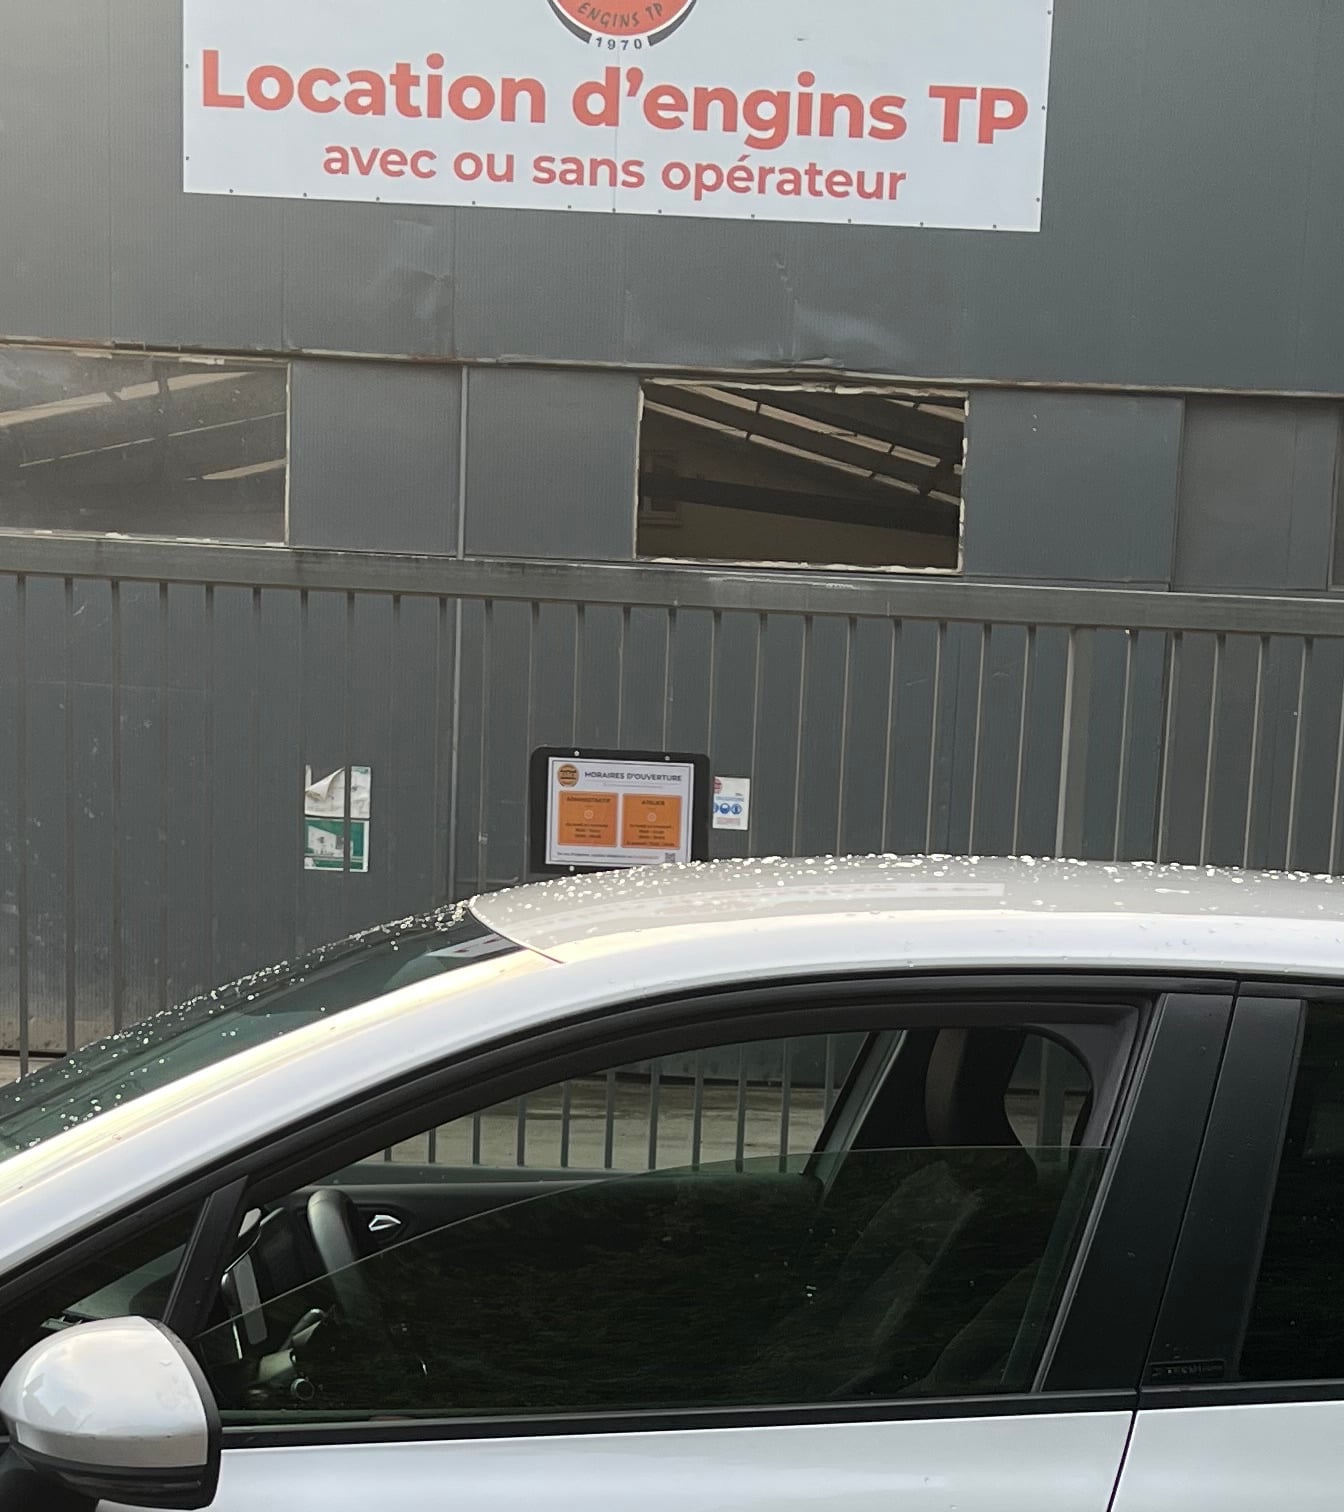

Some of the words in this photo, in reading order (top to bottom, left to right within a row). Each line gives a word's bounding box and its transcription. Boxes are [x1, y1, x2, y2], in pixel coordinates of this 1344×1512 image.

[577, 2, 641, 28] ENGINS
[645, 3, 664, 21] TP
[595, 37, 643, 51] 1970
[201, 49, 546, 123] Location
[928, 85, 1029, 145] TP
[322, 145, 434, 179] avec
[452, 151, 514, 182] ou
[533, 155, 645, 189] sans
[660, 155, 906, 201] opérateur
[584, 771, 625, 780] HORAIRES
